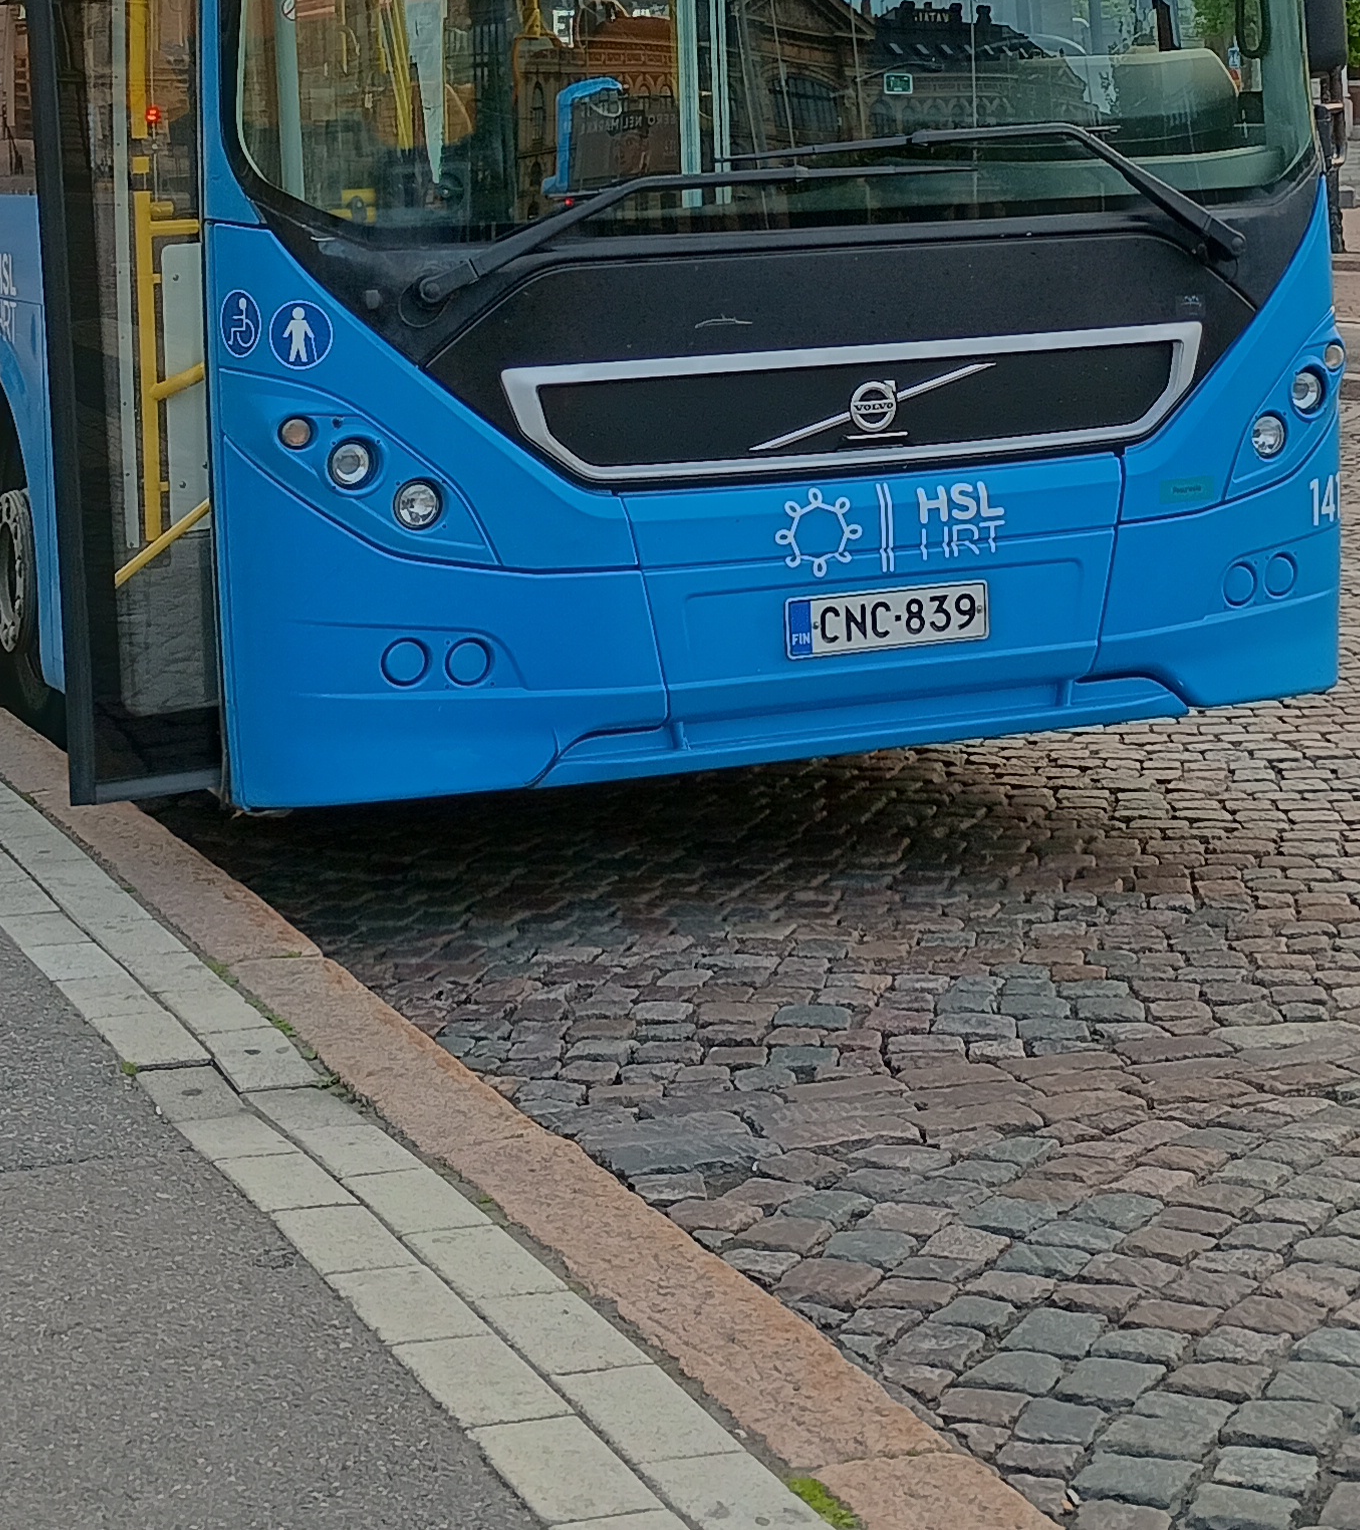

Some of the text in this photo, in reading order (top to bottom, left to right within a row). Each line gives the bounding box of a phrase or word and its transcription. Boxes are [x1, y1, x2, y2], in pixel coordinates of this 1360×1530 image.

[853, 402, 894, 412] VOLVO
[916, 480, 1005, 524] HSL
[1309, 470, 1341, 526] 14
[791, 632, 811, 646] FIN
[820, 593, 977, 644] CNC-839
